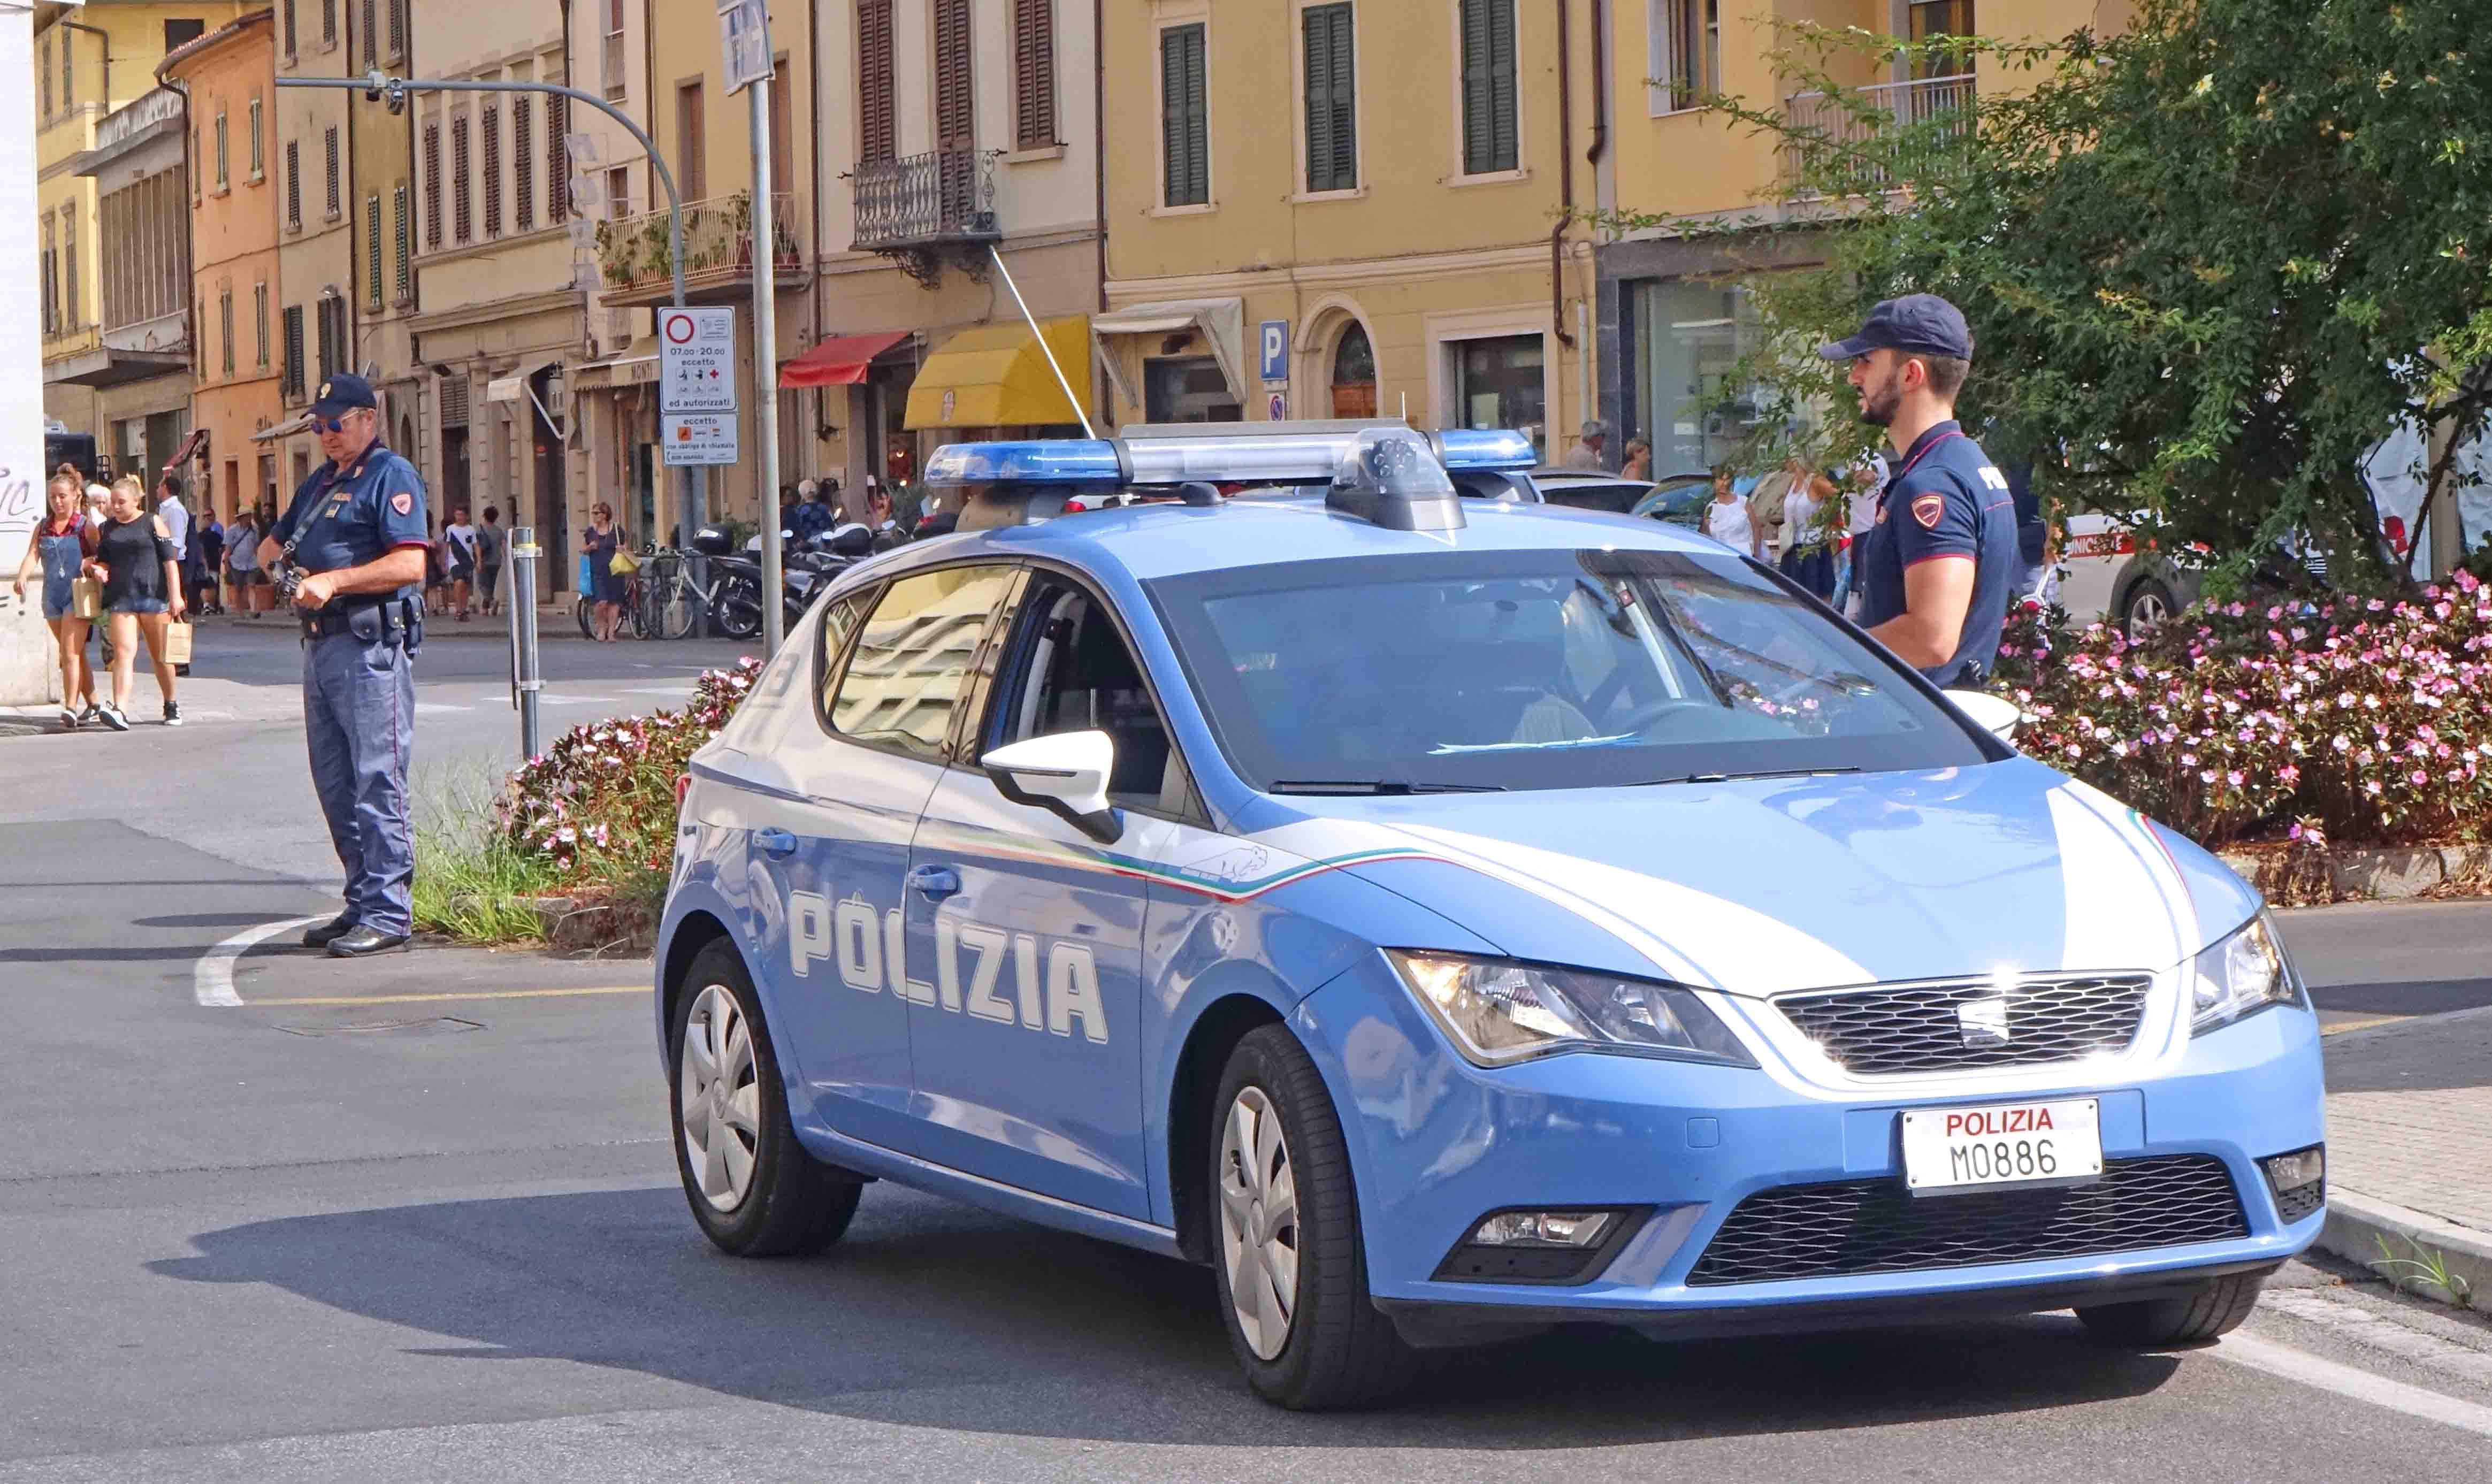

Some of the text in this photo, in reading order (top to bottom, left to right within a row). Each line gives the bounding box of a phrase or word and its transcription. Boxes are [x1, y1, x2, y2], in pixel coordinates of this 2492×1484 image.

[1265, 327, 1282, 373] P
[669, 398, 730, 407] ed autorizzati
[787, 889, 1109, 1045] POLIZIA
[1946, 1108, 2054, 1137] POLIZIA
[1950, 1139, 2057, 1182] M0886
